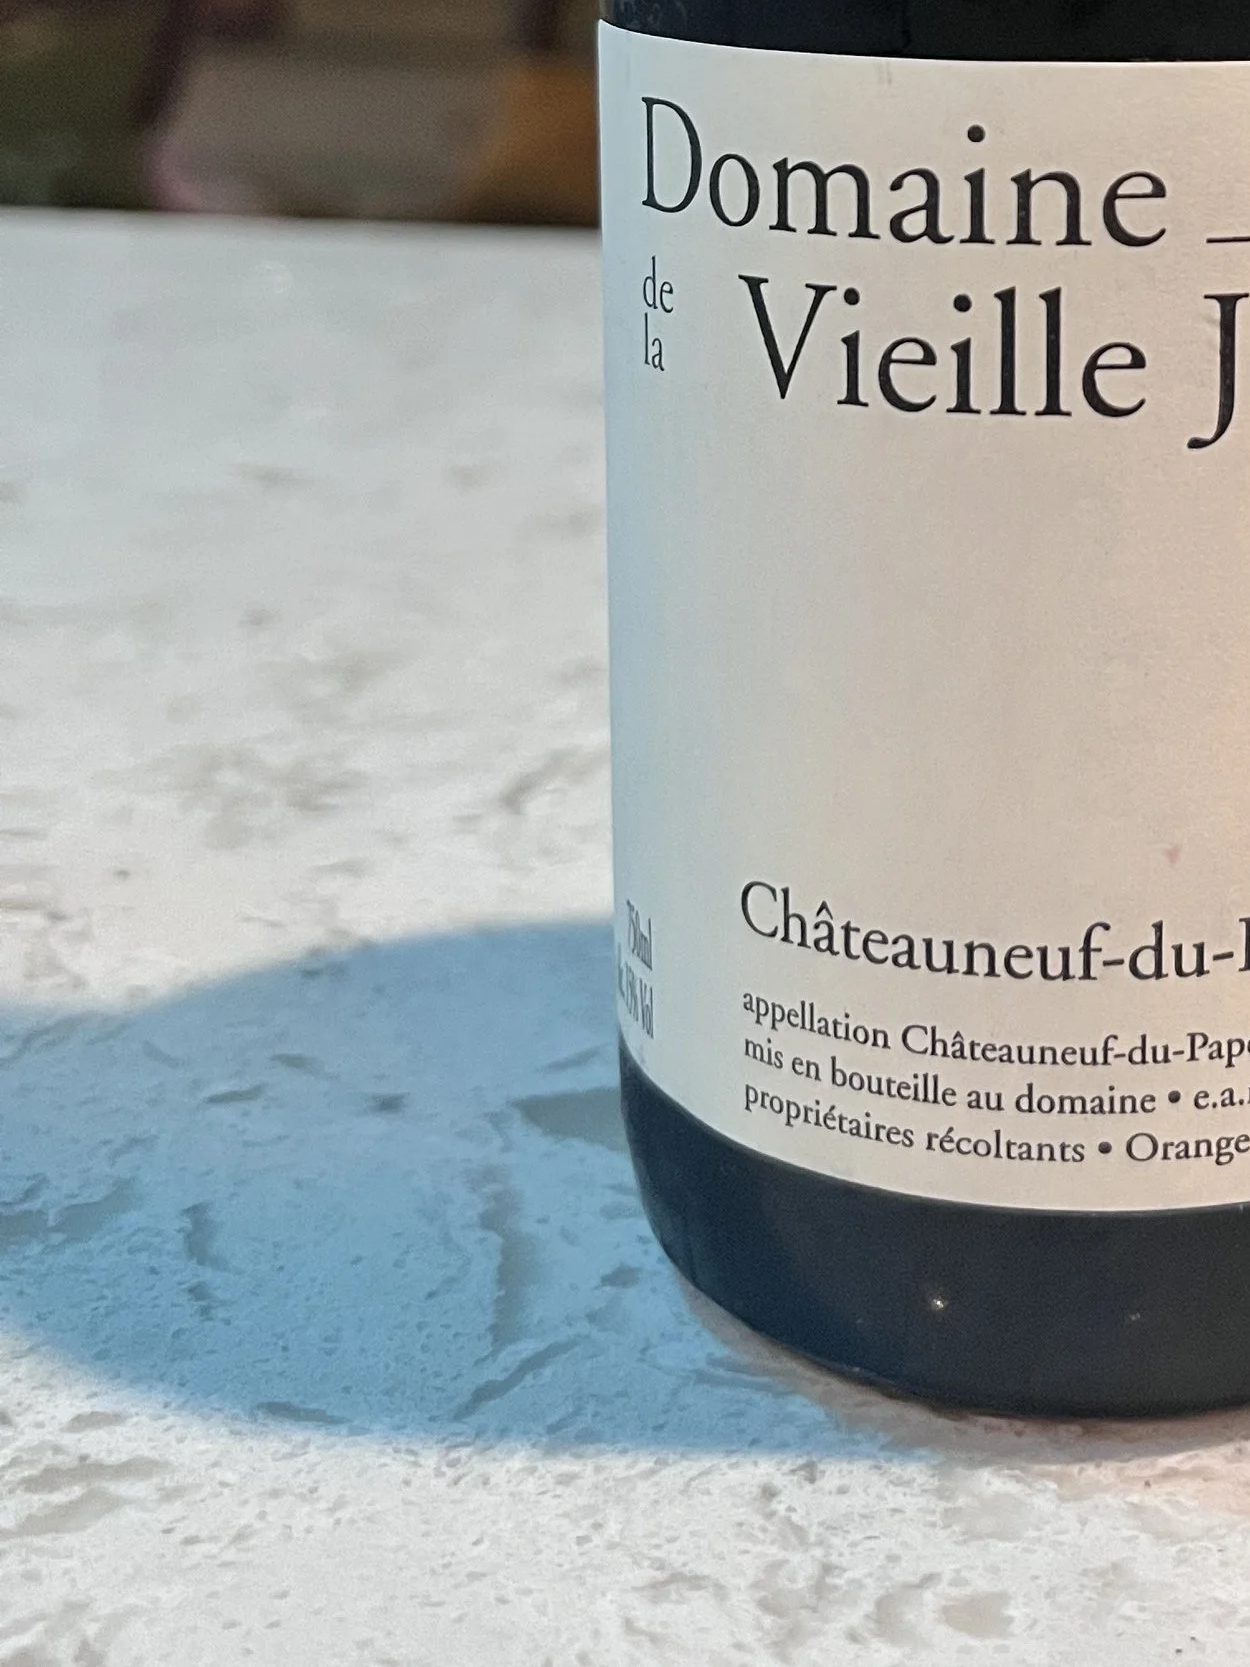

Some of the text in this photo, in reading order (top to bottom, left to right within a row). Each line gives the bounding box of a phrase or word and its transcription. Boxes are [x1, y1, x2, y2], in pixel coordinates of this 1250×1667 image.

[641, 96, 1167, 248] Domaine
[642, 256, 675, 314] de
[643, 311, 665, 372] la
[738, 274, 1148, 419] Vieille
[743, 992, 891, 1049] appellation
[744, 1037, 784, 1070] mis
[791, 1056, 822, 1082] en
[831, 1055, 957, 1107] bouteille
[966, 1090, 1005, 1112] au
[1014, 1081, 1157, 1115] domaine
[744, 1084, 915, 1148] propriétaires
[925, 1126, 1085, 1163] récoltants
[1126, 1132, 1250, 1166] Orange
